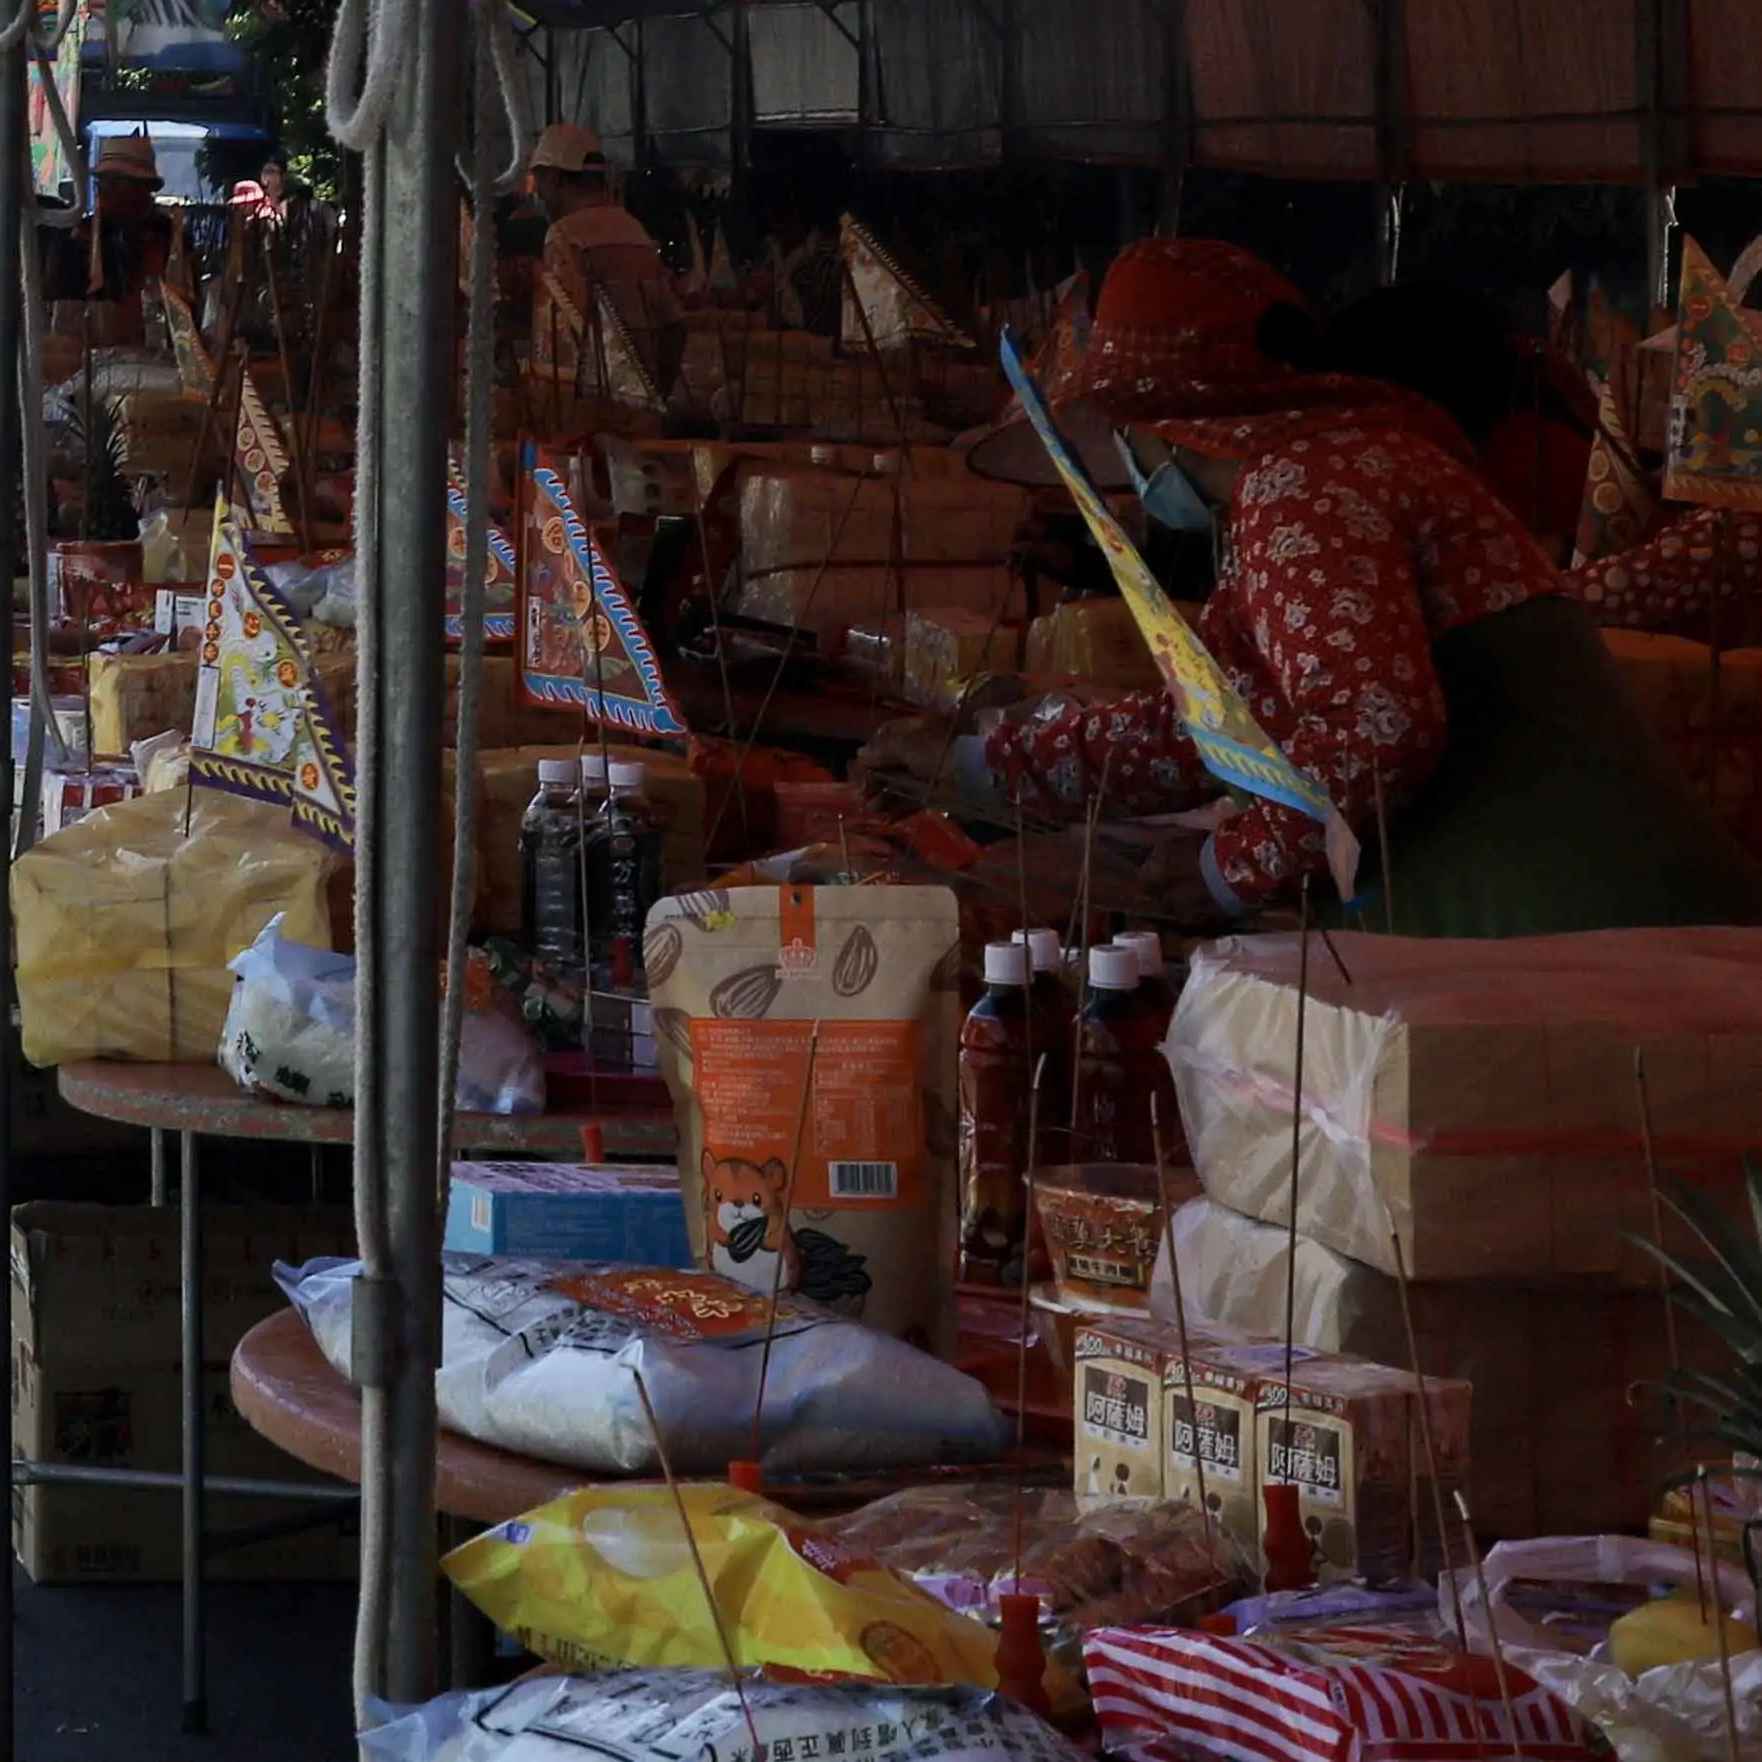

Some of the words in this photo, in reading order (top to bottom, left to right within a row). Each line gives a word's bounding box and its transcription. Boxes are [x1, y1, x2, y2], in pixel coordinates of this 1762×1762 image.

[1086, 1389, 1145, 1437] 阿薩姆
[1270, 1441, 1337, 1485] 阿薩姆
